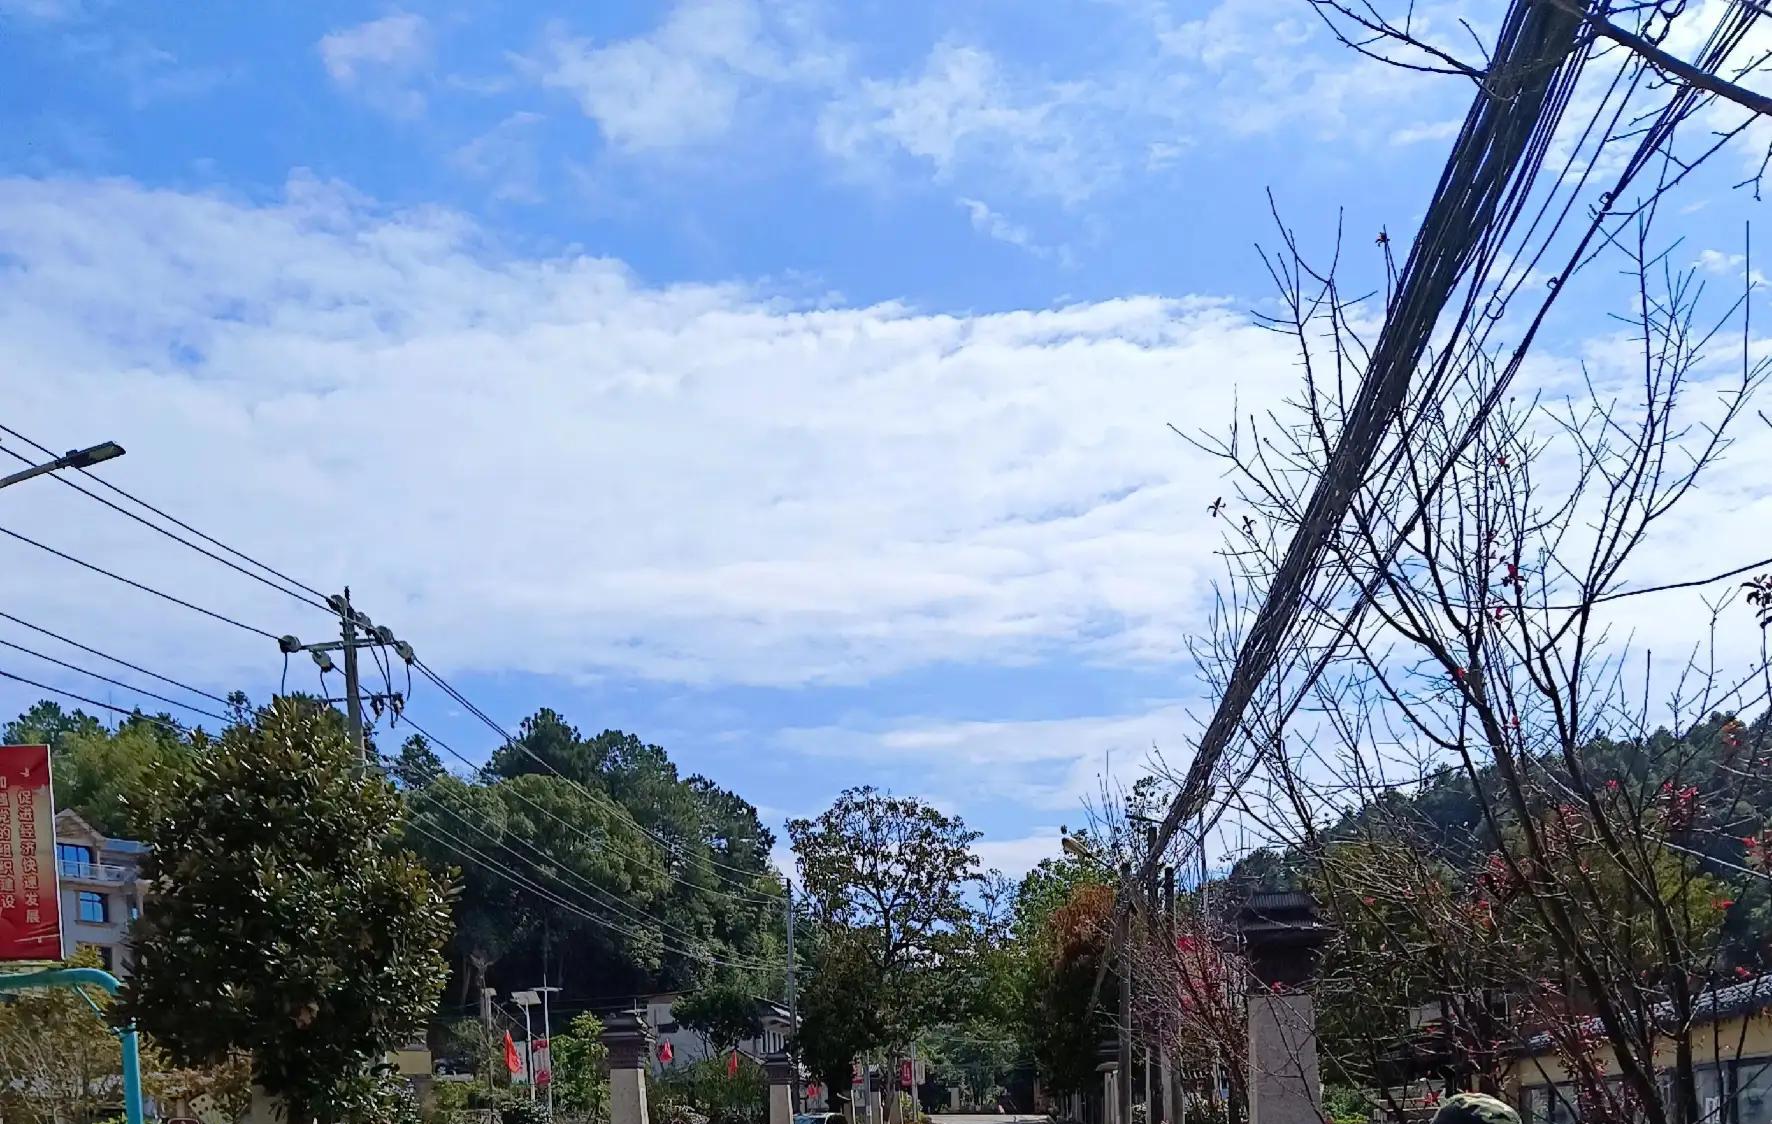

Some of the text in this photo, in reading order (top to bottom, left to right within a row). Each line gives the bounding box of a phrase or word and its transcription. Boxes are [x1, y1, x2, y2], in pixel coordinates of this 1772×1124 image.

[18, 789, 40, 923] 促进经济快速发展
